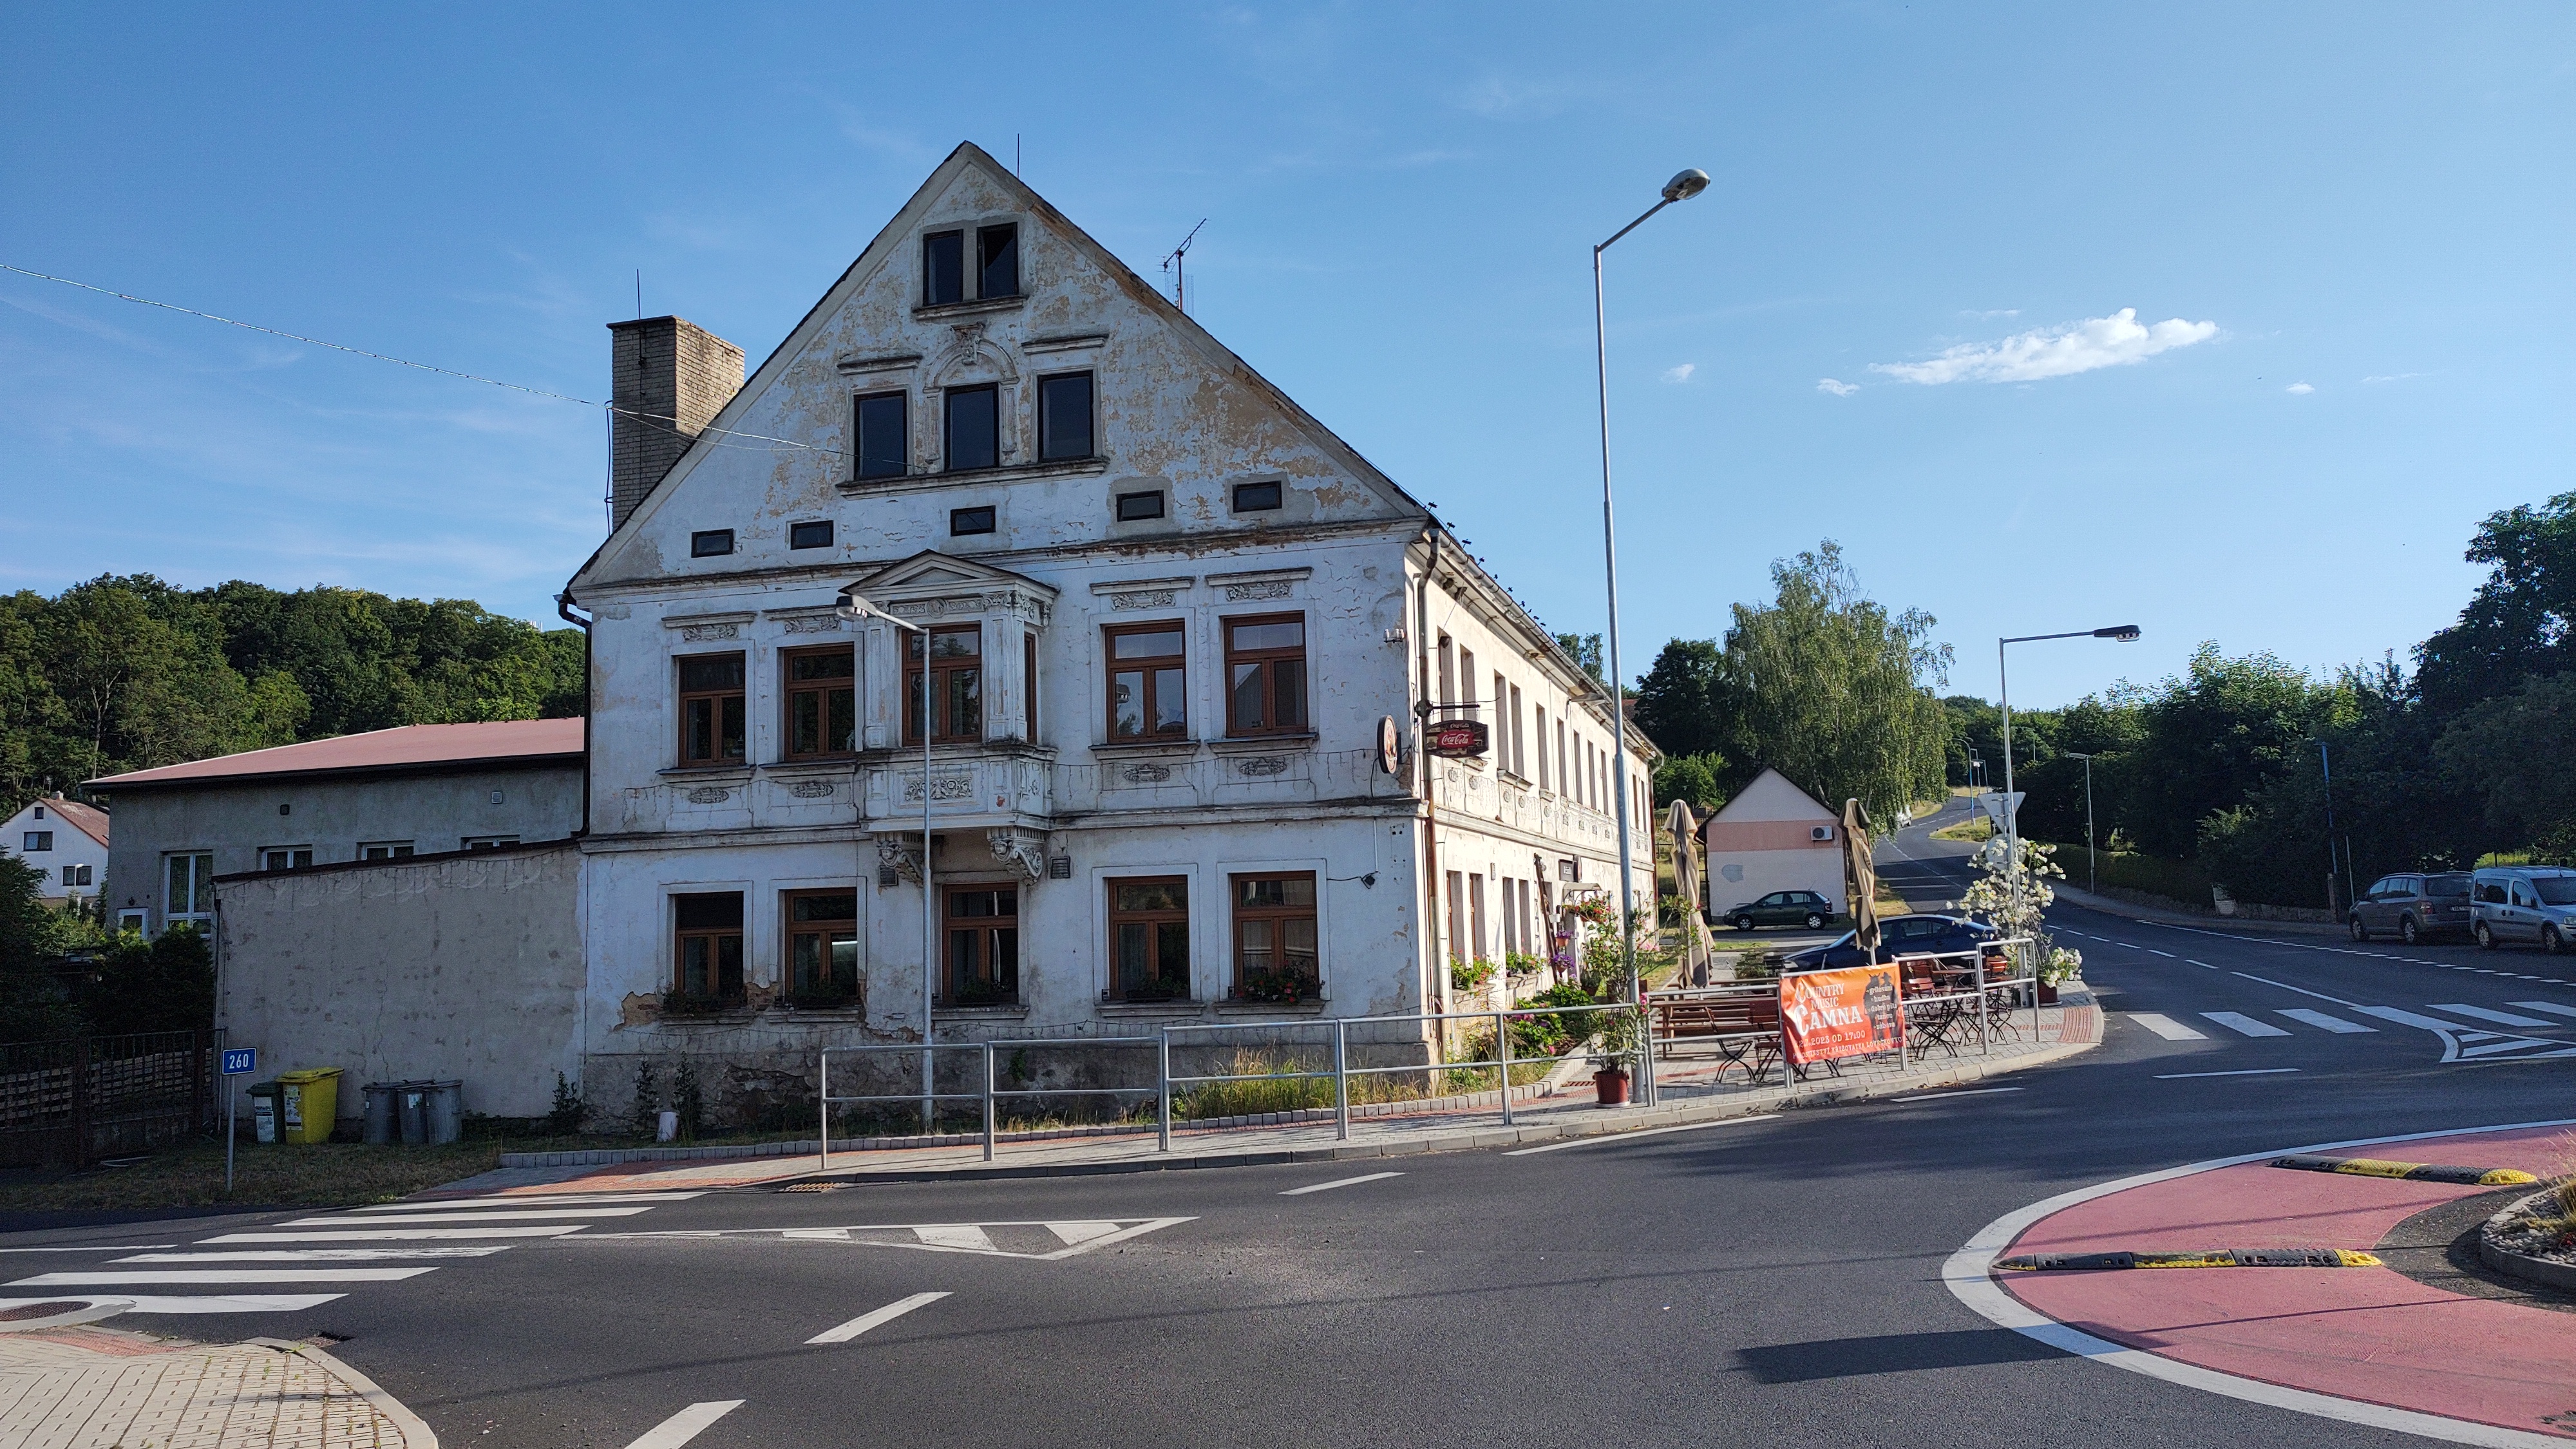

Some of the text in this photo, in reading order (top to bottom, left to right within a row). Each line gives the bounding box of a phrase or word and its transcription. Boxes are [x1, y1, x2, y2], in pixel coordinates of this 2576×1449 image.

[1811, 996, 1839, 1010] MUSIC
[1873, 994, 1891, 1003] hudba
[1832, 1034, 1842, 1043] OD
[229, 1054, 249, 1069] 260
